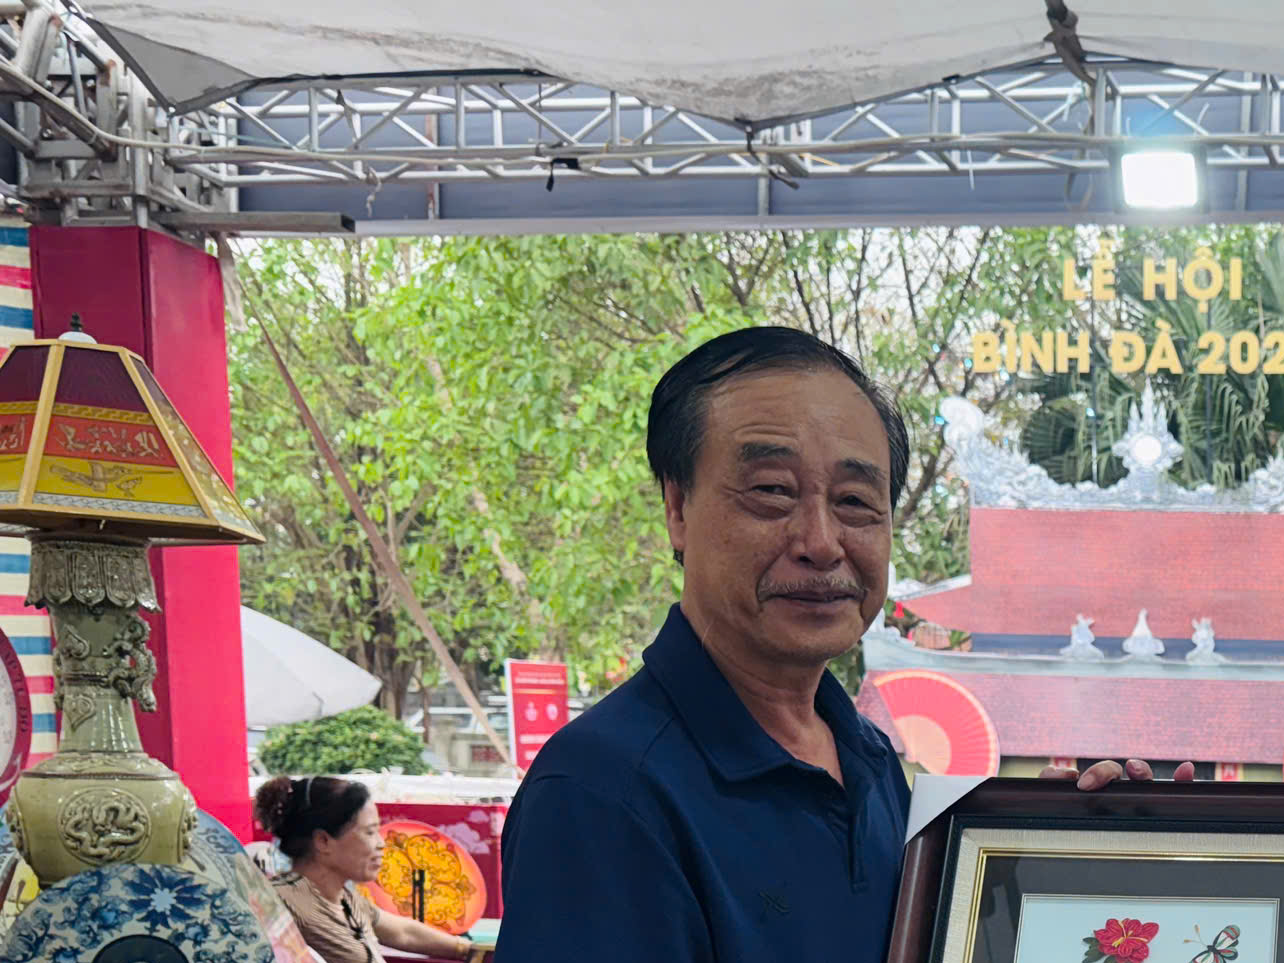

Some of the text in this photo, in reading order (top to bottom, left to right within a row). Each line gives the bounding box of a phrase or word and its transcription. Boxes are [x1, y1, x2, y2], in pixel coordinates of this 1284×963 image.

[1063, 239, 1243, 313] LỄ HỘI
[972, 319, 1091, 374] BÌNH
[1110, 318, 1184, 375] ĐÀ
